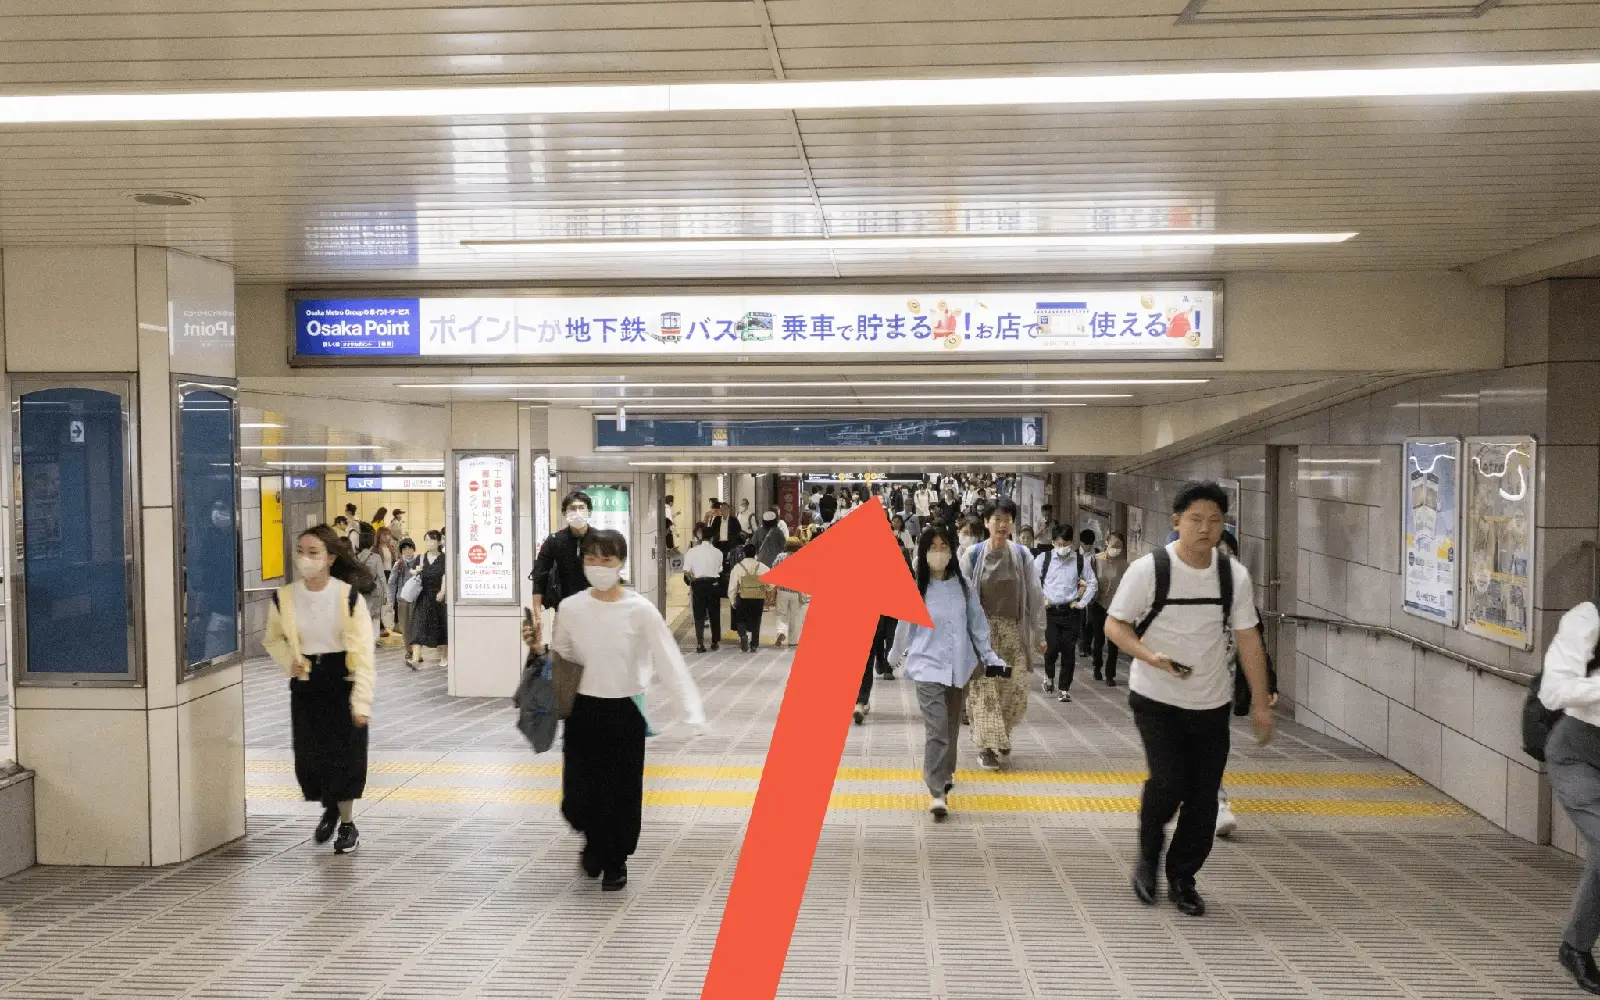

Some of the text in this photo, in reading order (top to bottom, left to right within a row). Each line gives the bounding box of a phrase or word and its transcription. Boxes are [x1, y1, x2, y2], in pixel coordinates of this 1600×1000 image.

[306, 319, 410, 337] Osaka Point
[358, 479, 374, 488] JR
